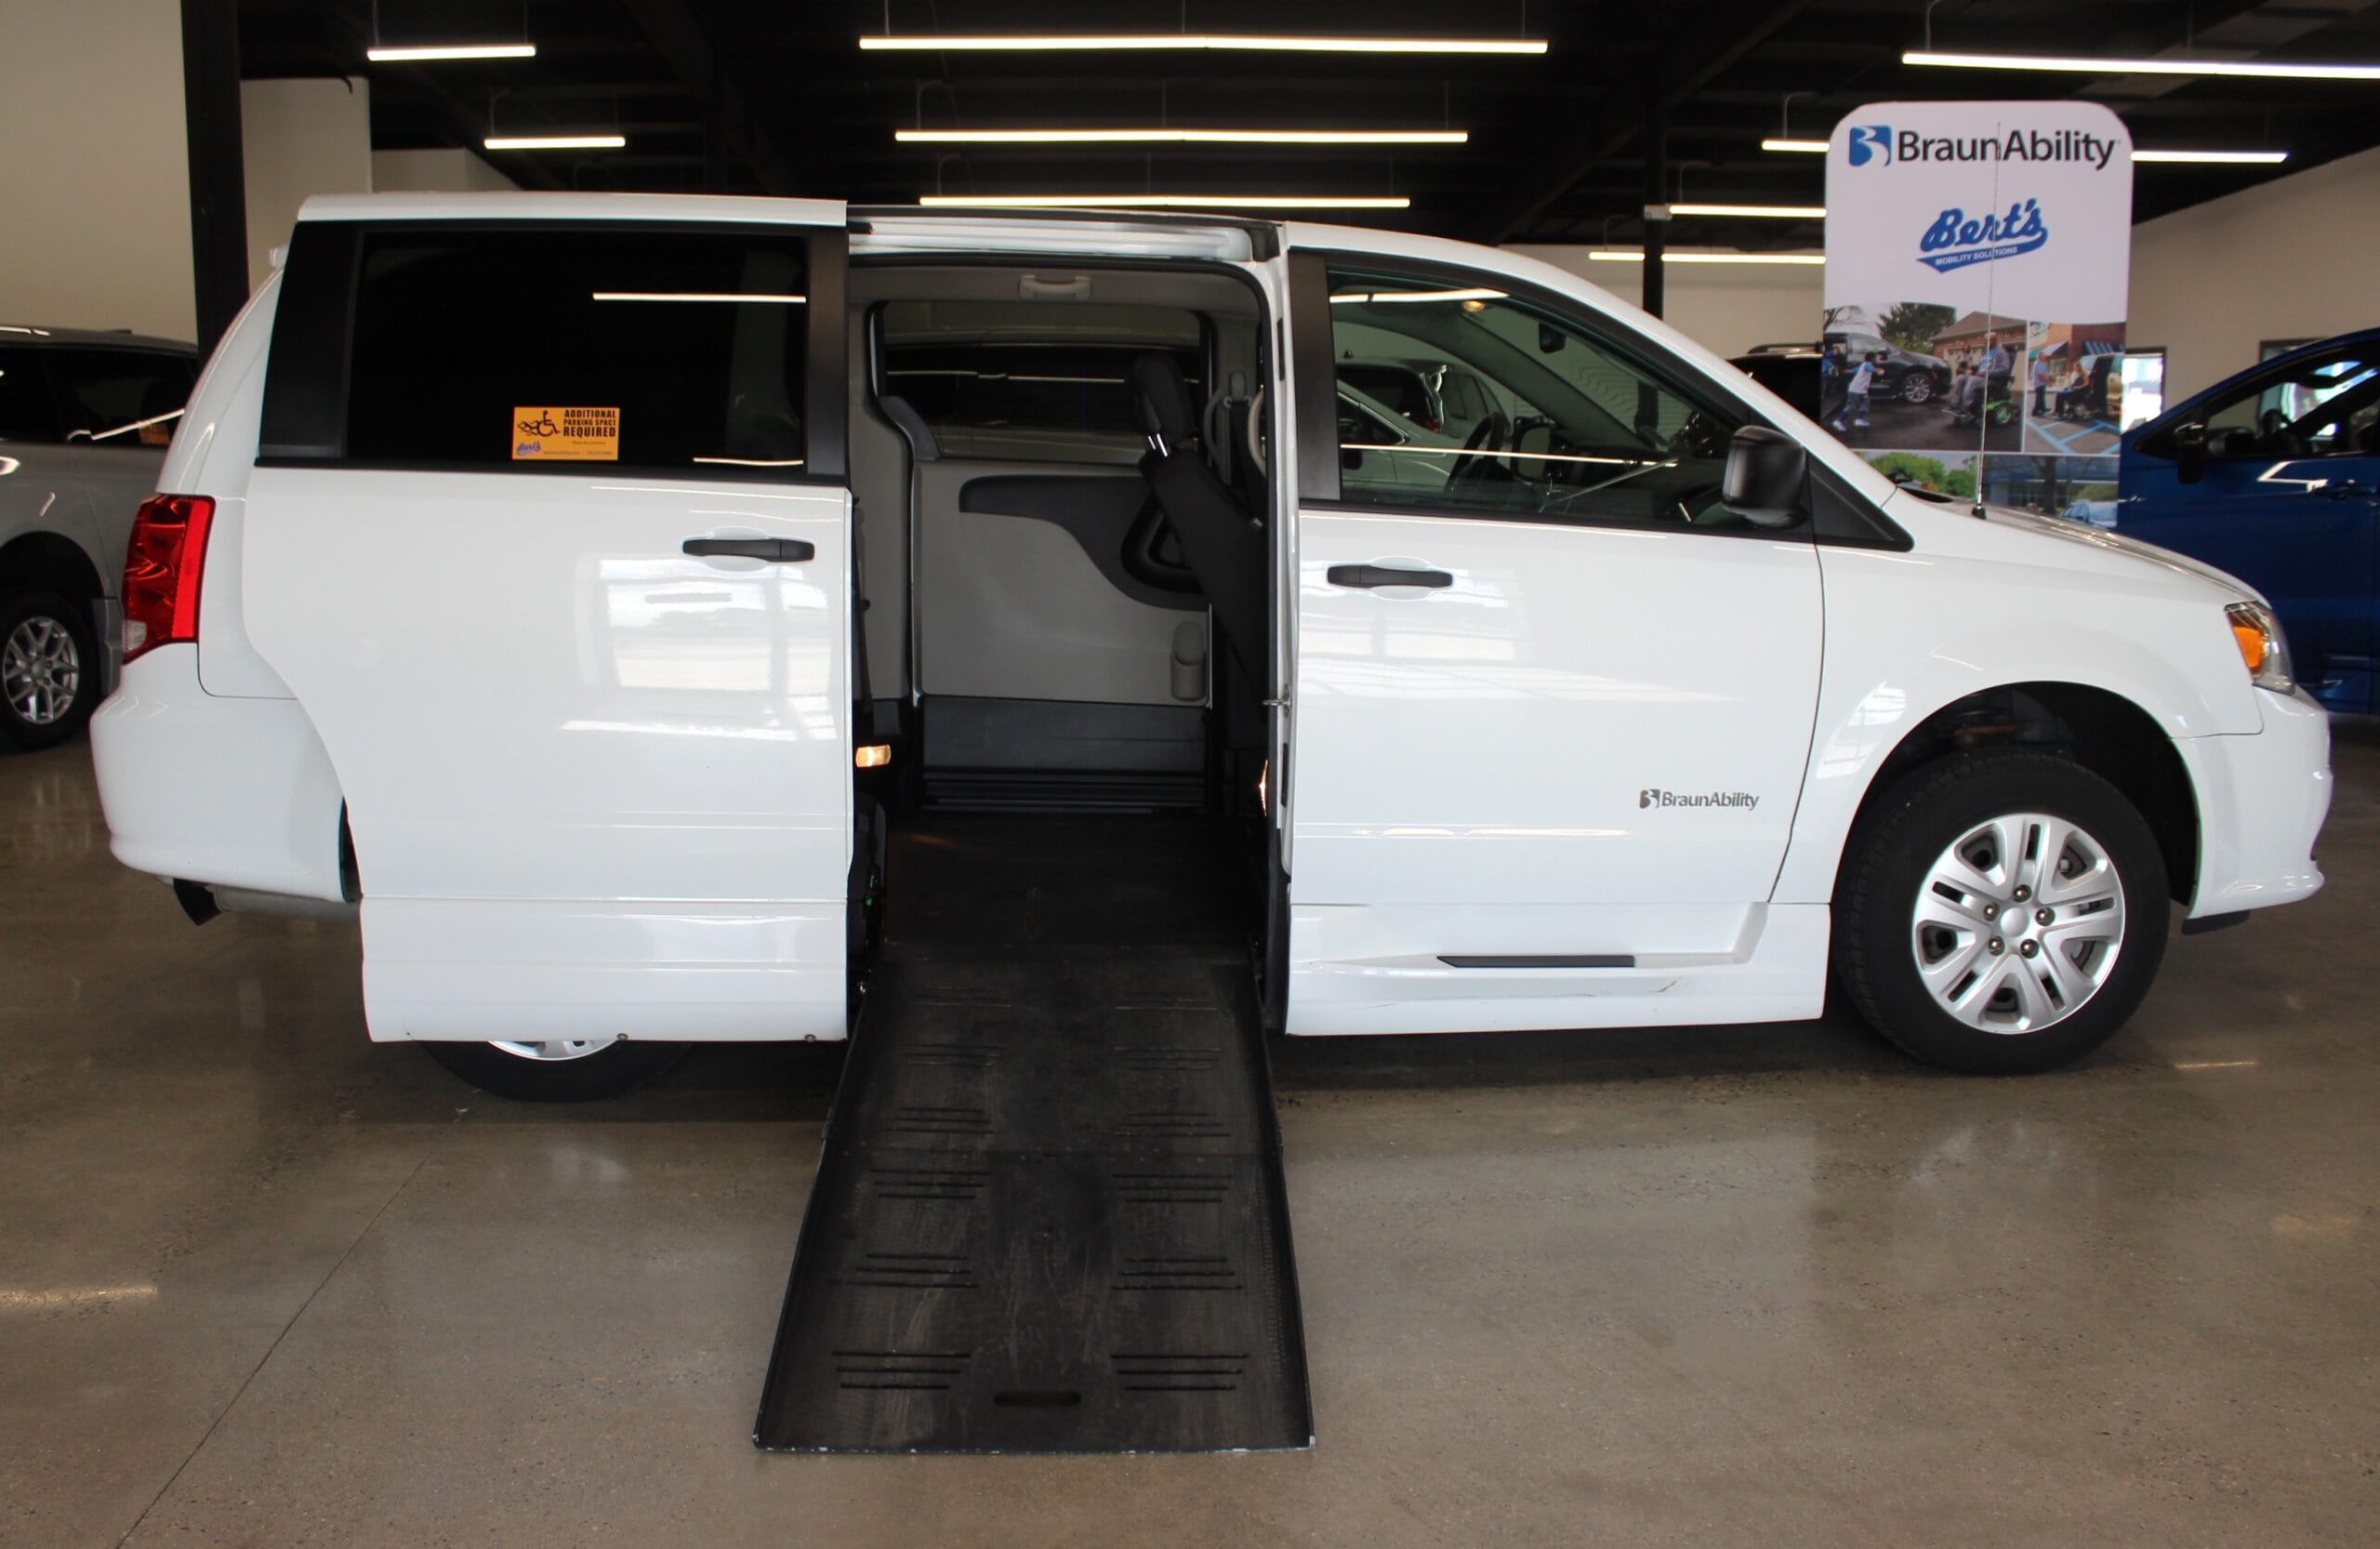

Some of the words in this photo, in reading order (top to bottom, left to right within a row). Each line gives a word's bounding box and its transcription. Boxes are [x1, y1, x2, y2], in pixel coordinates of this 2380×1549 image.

[1897, 129, 2117, 171] BraunAbility
[1920, 197, 2042, 252] Bert's
[1935, 253, 1973, 266] MOBILITY
[564, 409, 616, 418] ADDITIONAL
[563, 418, 593, 427] PARKING
[595, 418, 616, 427] SPACE
[563, 426, 616, 438] REQUIRED
[1661, 791, 1760, 812] BraunAbility
